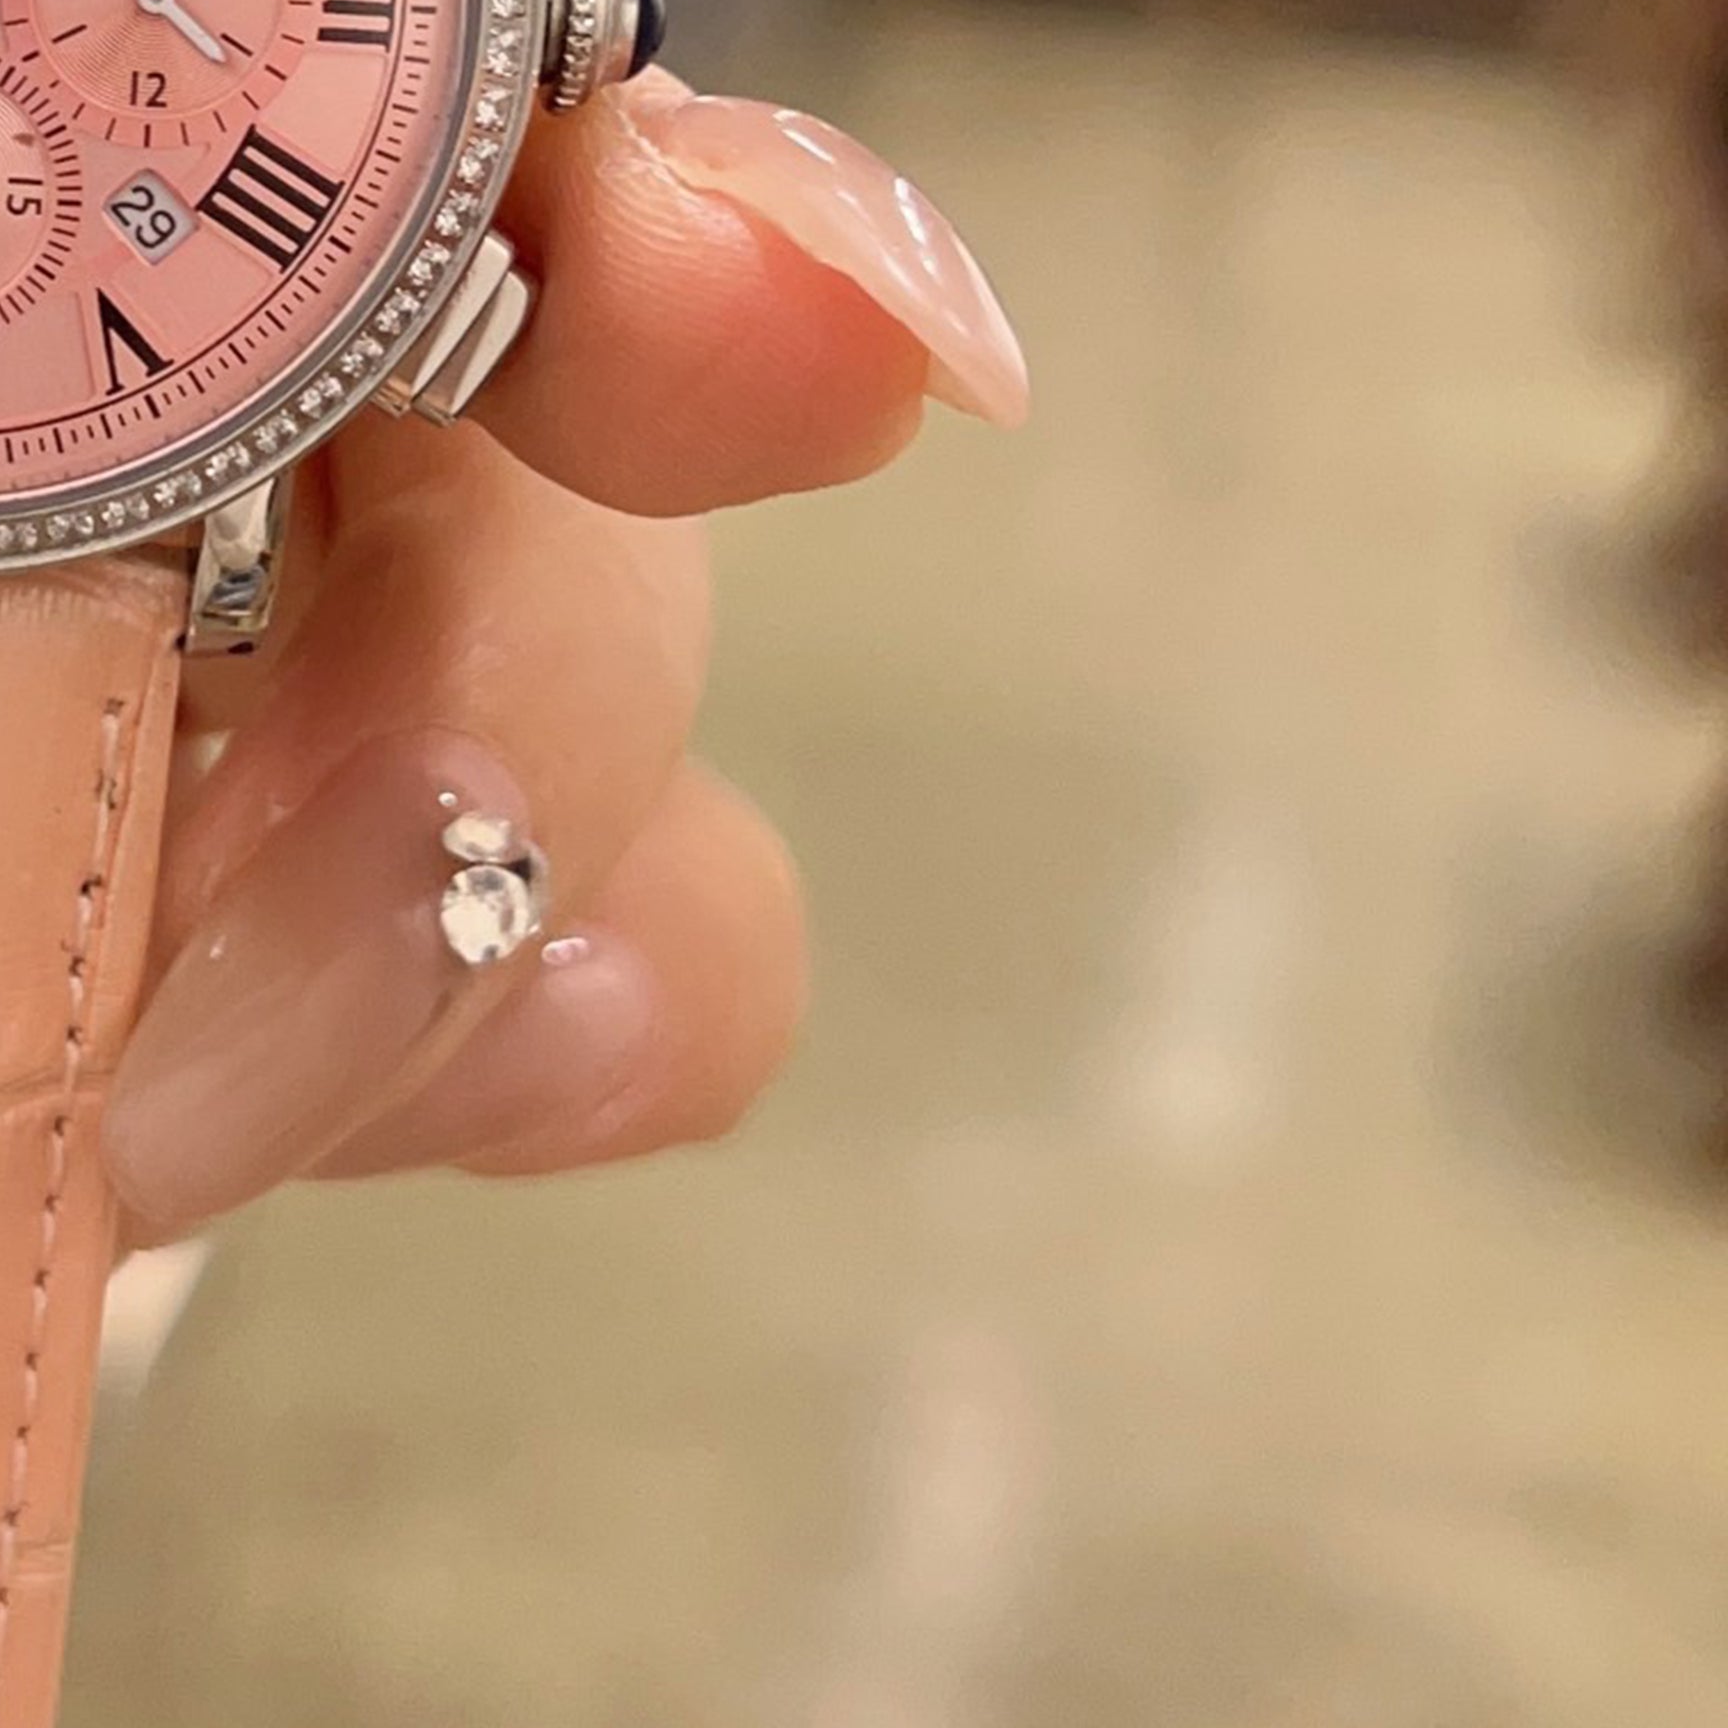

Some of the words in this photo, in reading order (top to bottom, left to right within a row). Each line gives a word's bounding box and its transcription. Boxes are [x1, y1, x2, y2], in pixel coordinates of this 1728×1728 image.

[130, 71, 168, 108] 12
[7, 176, 44, 216] 15
[111, 186, 176, 249] 29
[194, 123, 345, 273] IIII
[96, 287, 174, 396] V
